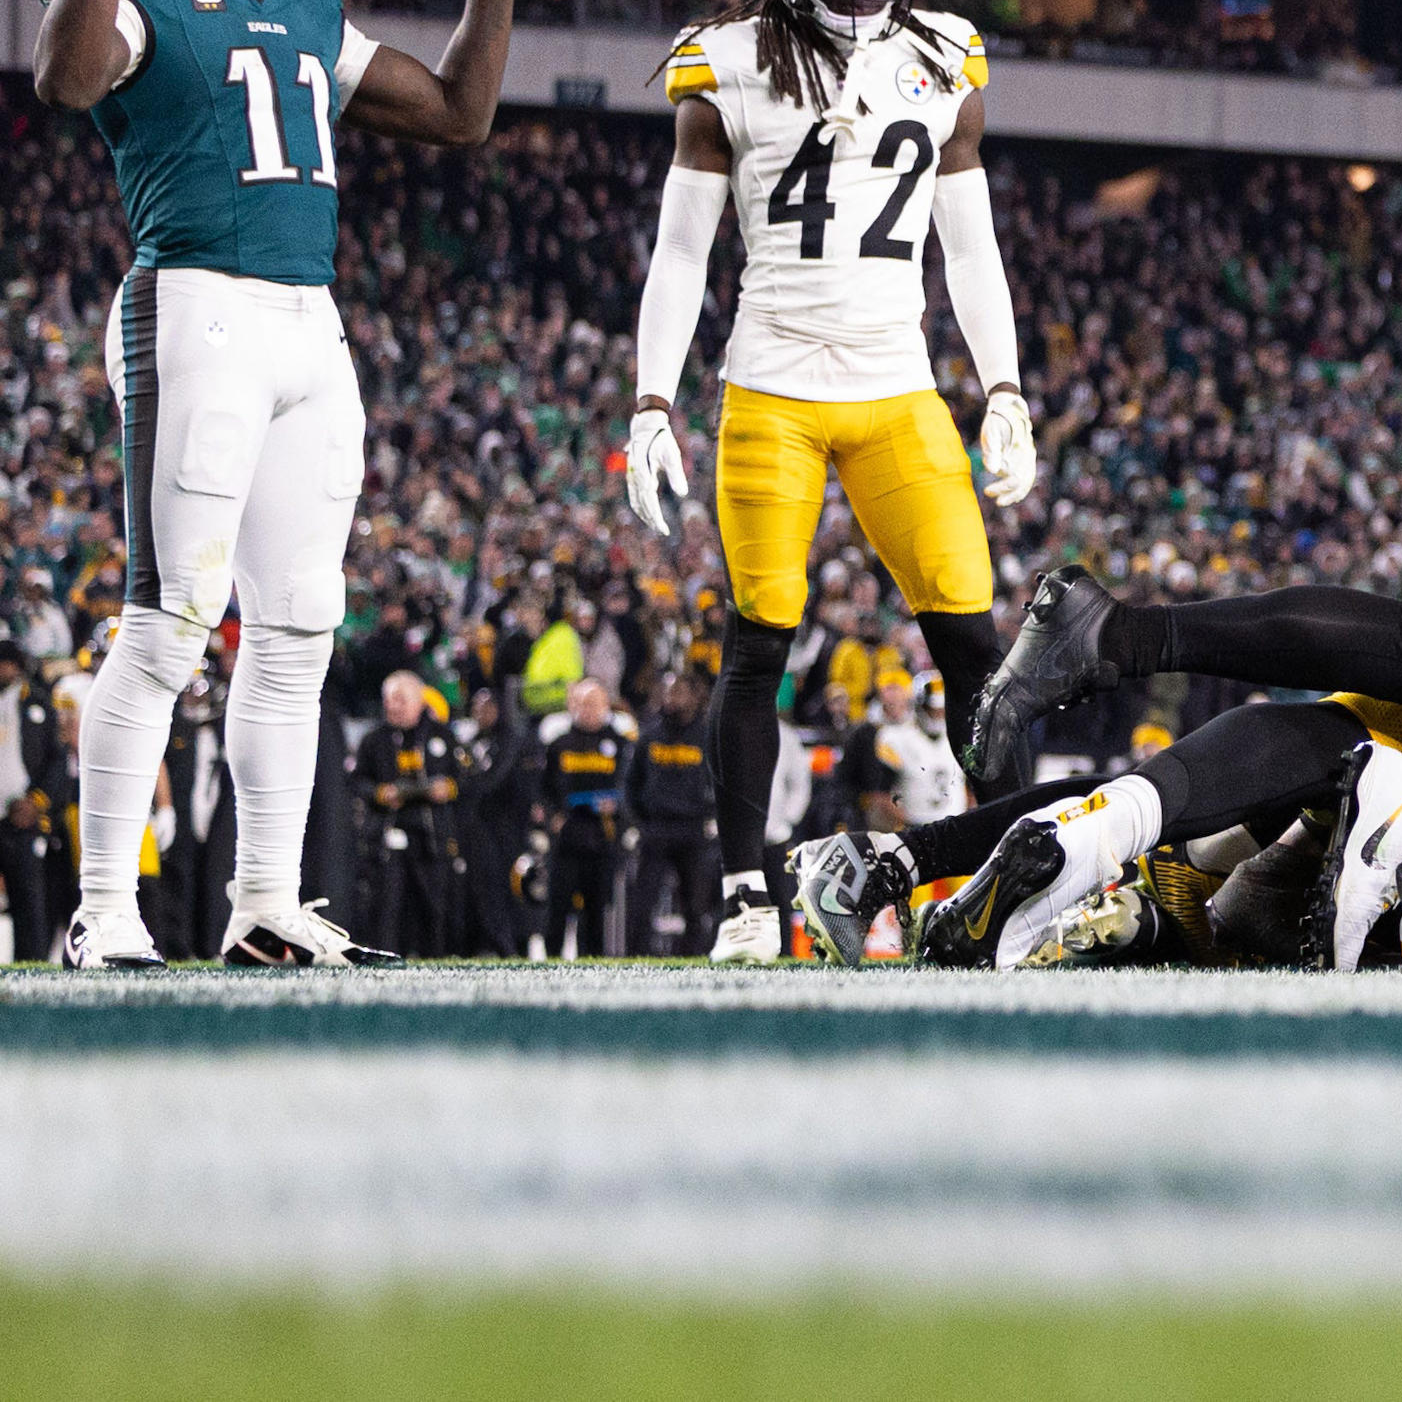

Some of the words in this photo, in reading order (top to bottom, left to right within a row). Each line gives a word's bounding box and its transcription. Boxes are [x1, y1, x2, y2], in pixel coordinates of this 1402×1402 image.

[247, 21, 287, 35] EAGLES
[225, 46, 337, 188] 11
[768, 119, 935, 262] 42
